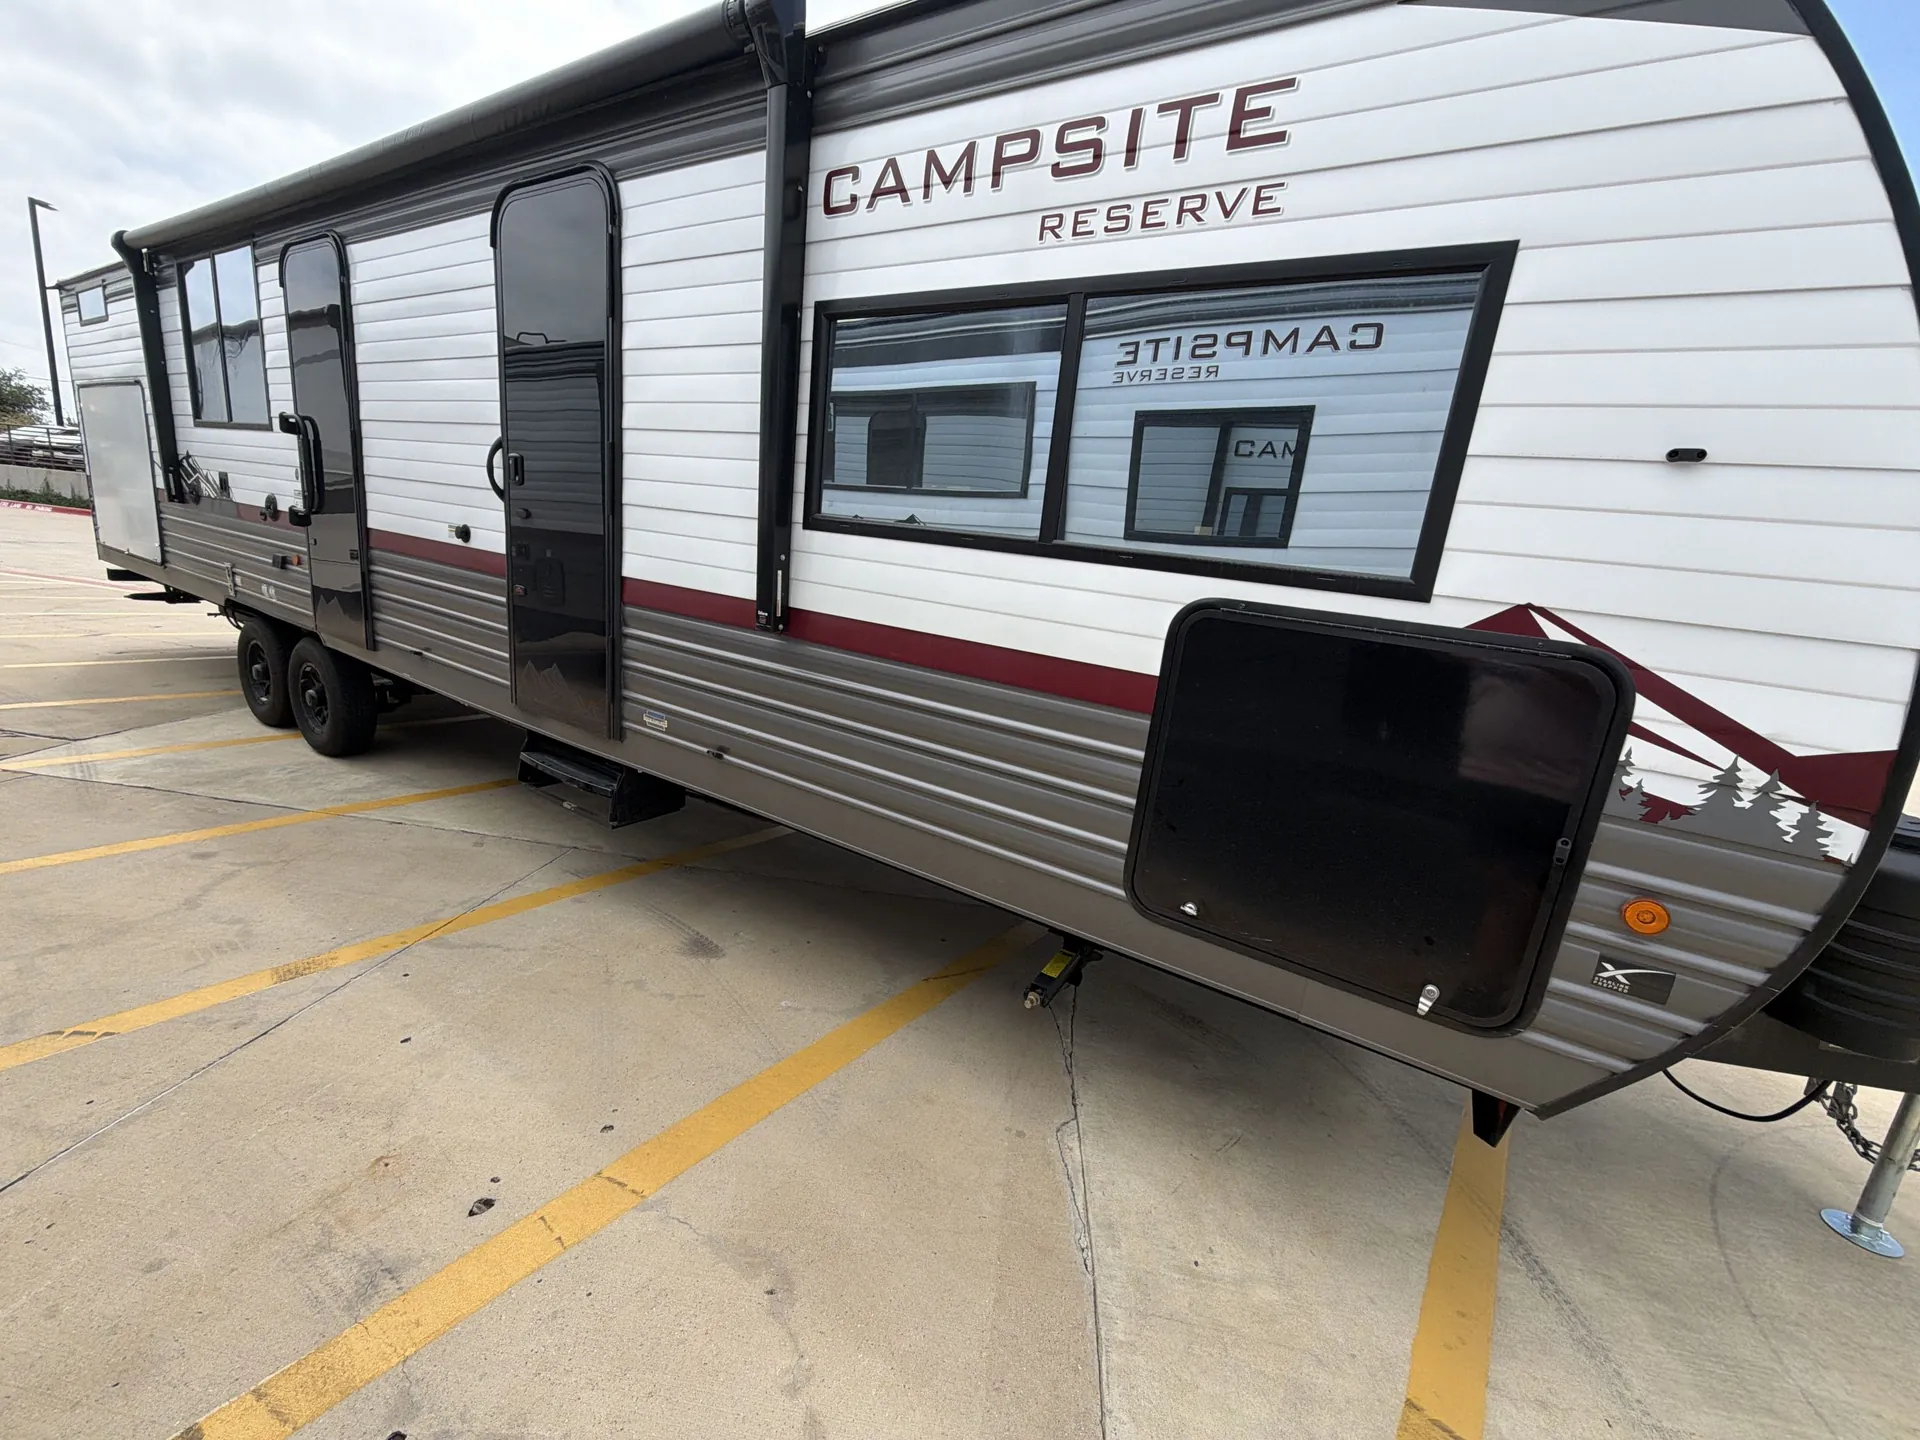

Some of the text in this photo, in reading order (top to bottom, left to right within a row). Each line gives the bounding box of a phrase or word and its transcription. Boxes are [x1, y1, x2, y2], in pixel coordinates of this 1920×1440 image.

[822, 76, 1299, 218] CAMPSITE
[1037, 182, 1288, 242] RESERVE
[1592, 980, 1629, 994] PREPPED
[1594, 976, 1630, 990] STARLINK
